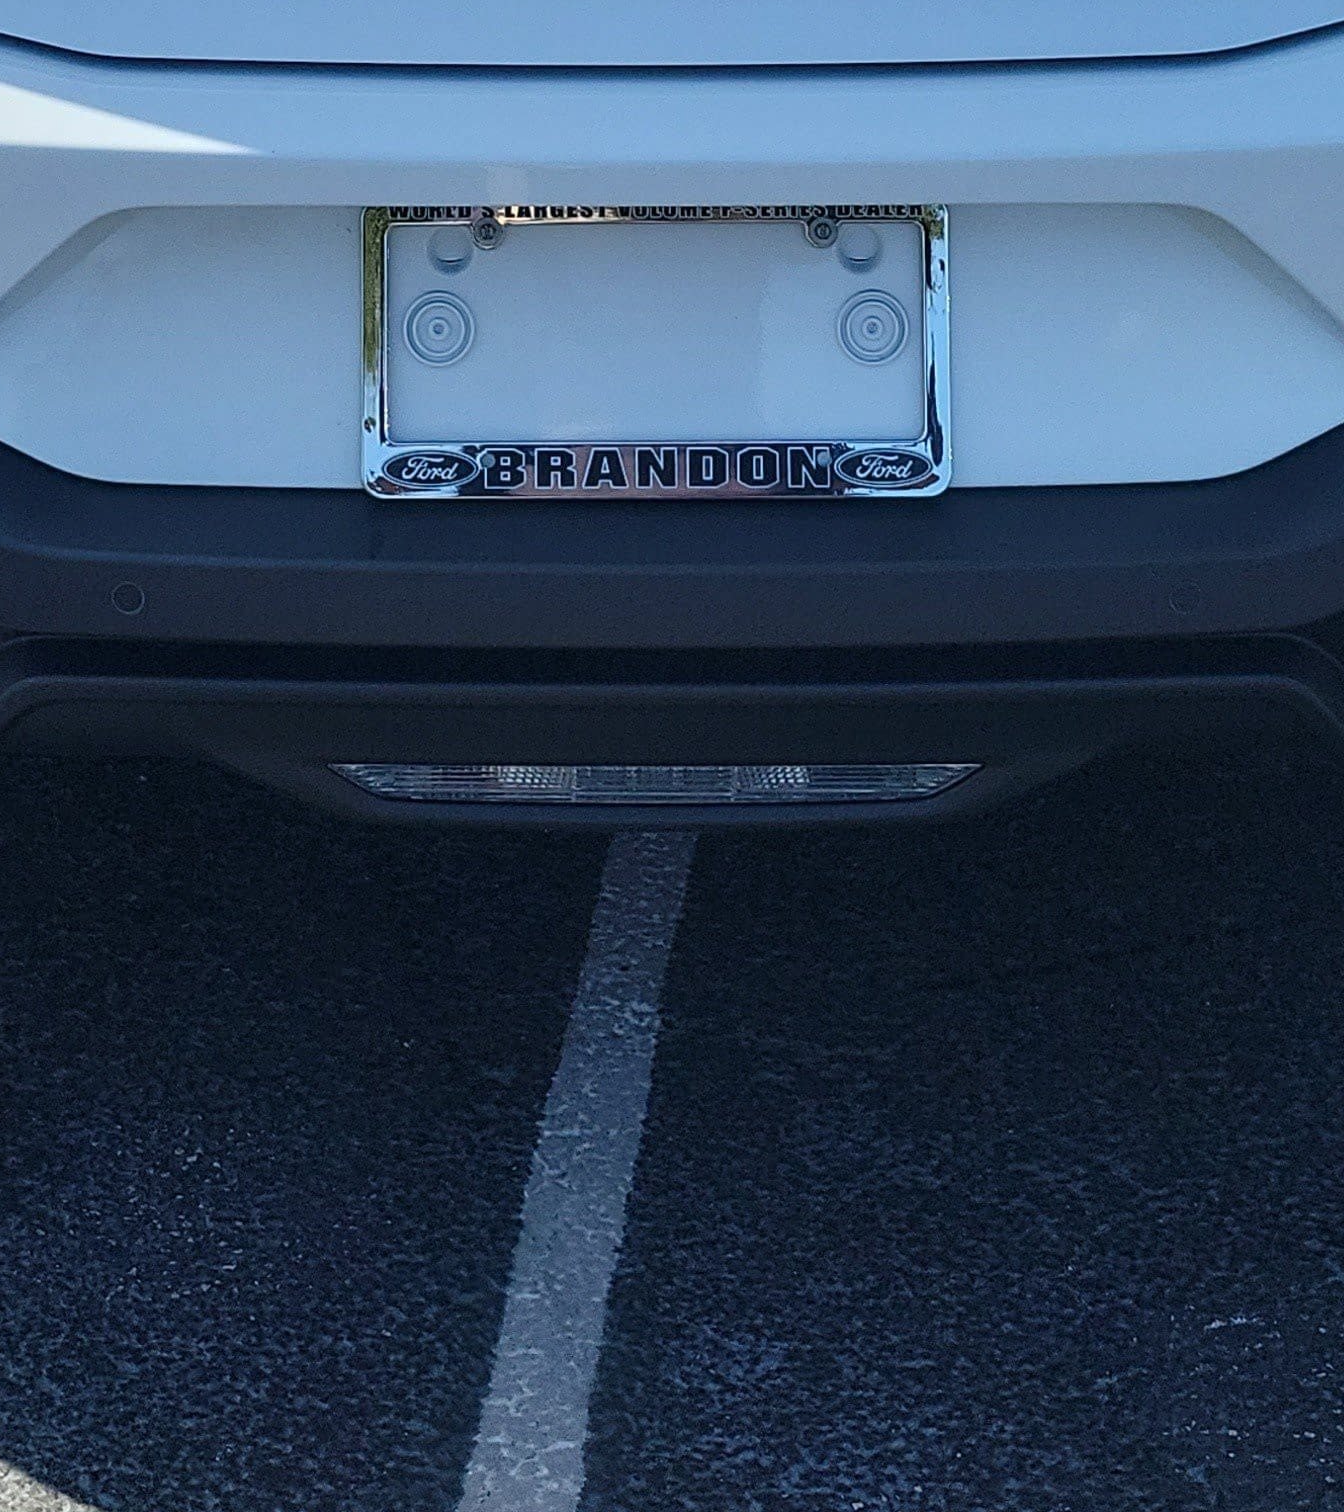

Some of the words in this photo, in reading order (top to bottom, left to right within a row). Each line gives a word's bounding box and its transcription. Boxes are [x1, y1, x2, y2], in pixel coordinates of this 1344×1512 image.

[389, 206, 496, 219] WORLDS
[505, 206, 610, 219] LARGEST
[401, 455, 458, 481] Ford
[484, 446, 831, 489] BRANDON
[855, 453, 914, 479] Ford
